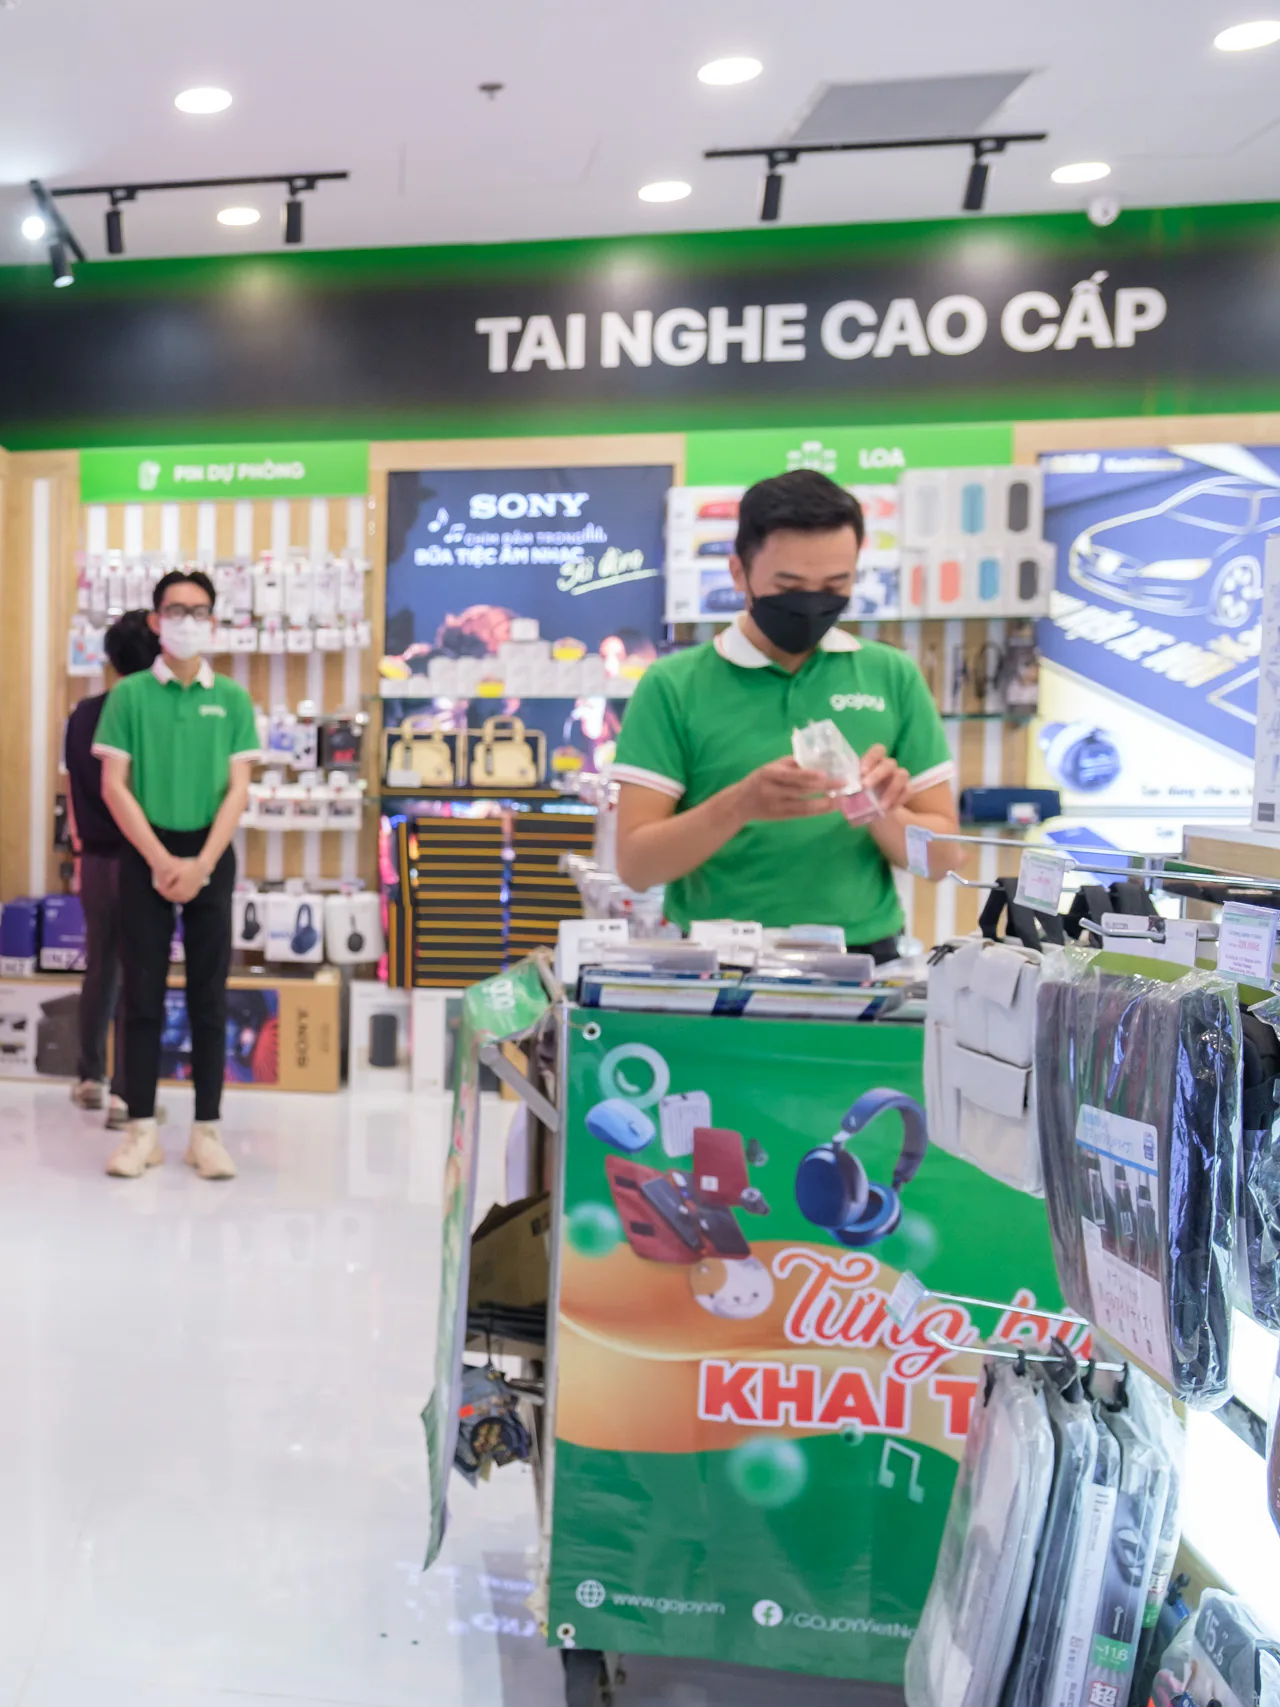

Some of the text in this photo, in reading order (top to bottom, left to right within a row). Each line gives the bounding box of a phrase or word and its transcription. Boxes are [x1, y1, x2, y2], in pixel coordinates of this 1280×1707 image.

[475, 270, 1167, 373] TAI NGHE CAO CẤP
[859, 449, 906, 470] LOA
[470, 492, 589, 519] SONY
[701, 1360, 908, 1432] KHAI
